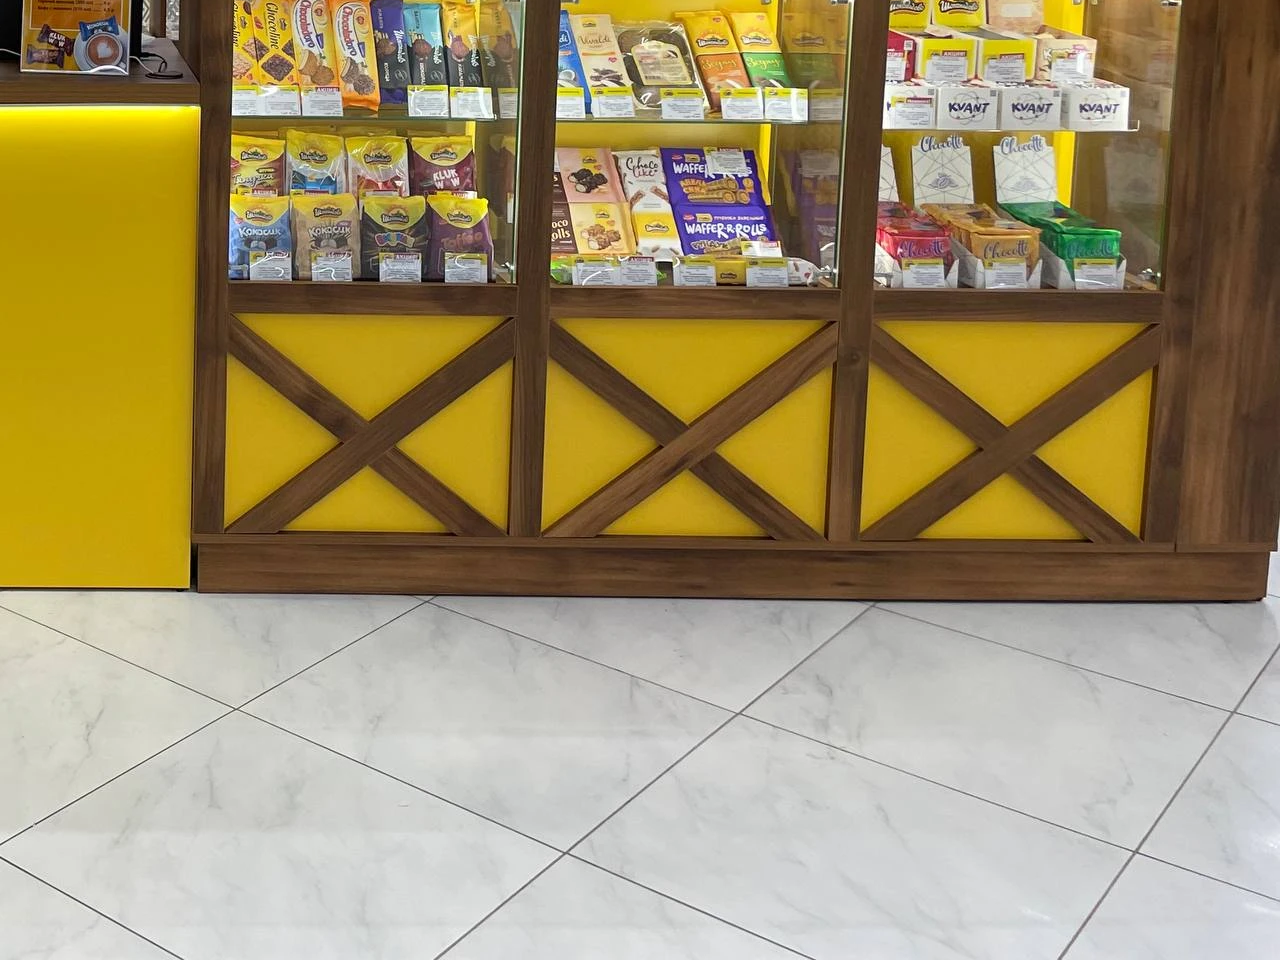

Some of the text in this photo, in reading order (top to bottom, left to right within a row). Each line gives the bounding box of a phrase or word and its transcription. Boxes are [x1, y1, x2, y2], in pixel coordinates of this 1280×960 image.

[266, 2, 279, 50] Chocoline
[948, 102, 991, 114] KVANT
[1011, 102, 1054, 114] KVANT
[1079, 103, 1121, 115] KVANT
[626, 156, 659, 171] Choco
[432, 168, 459, 181] KLUK
[551, 219, 569, 228] oco
[551, 229, 571, 241] olls
